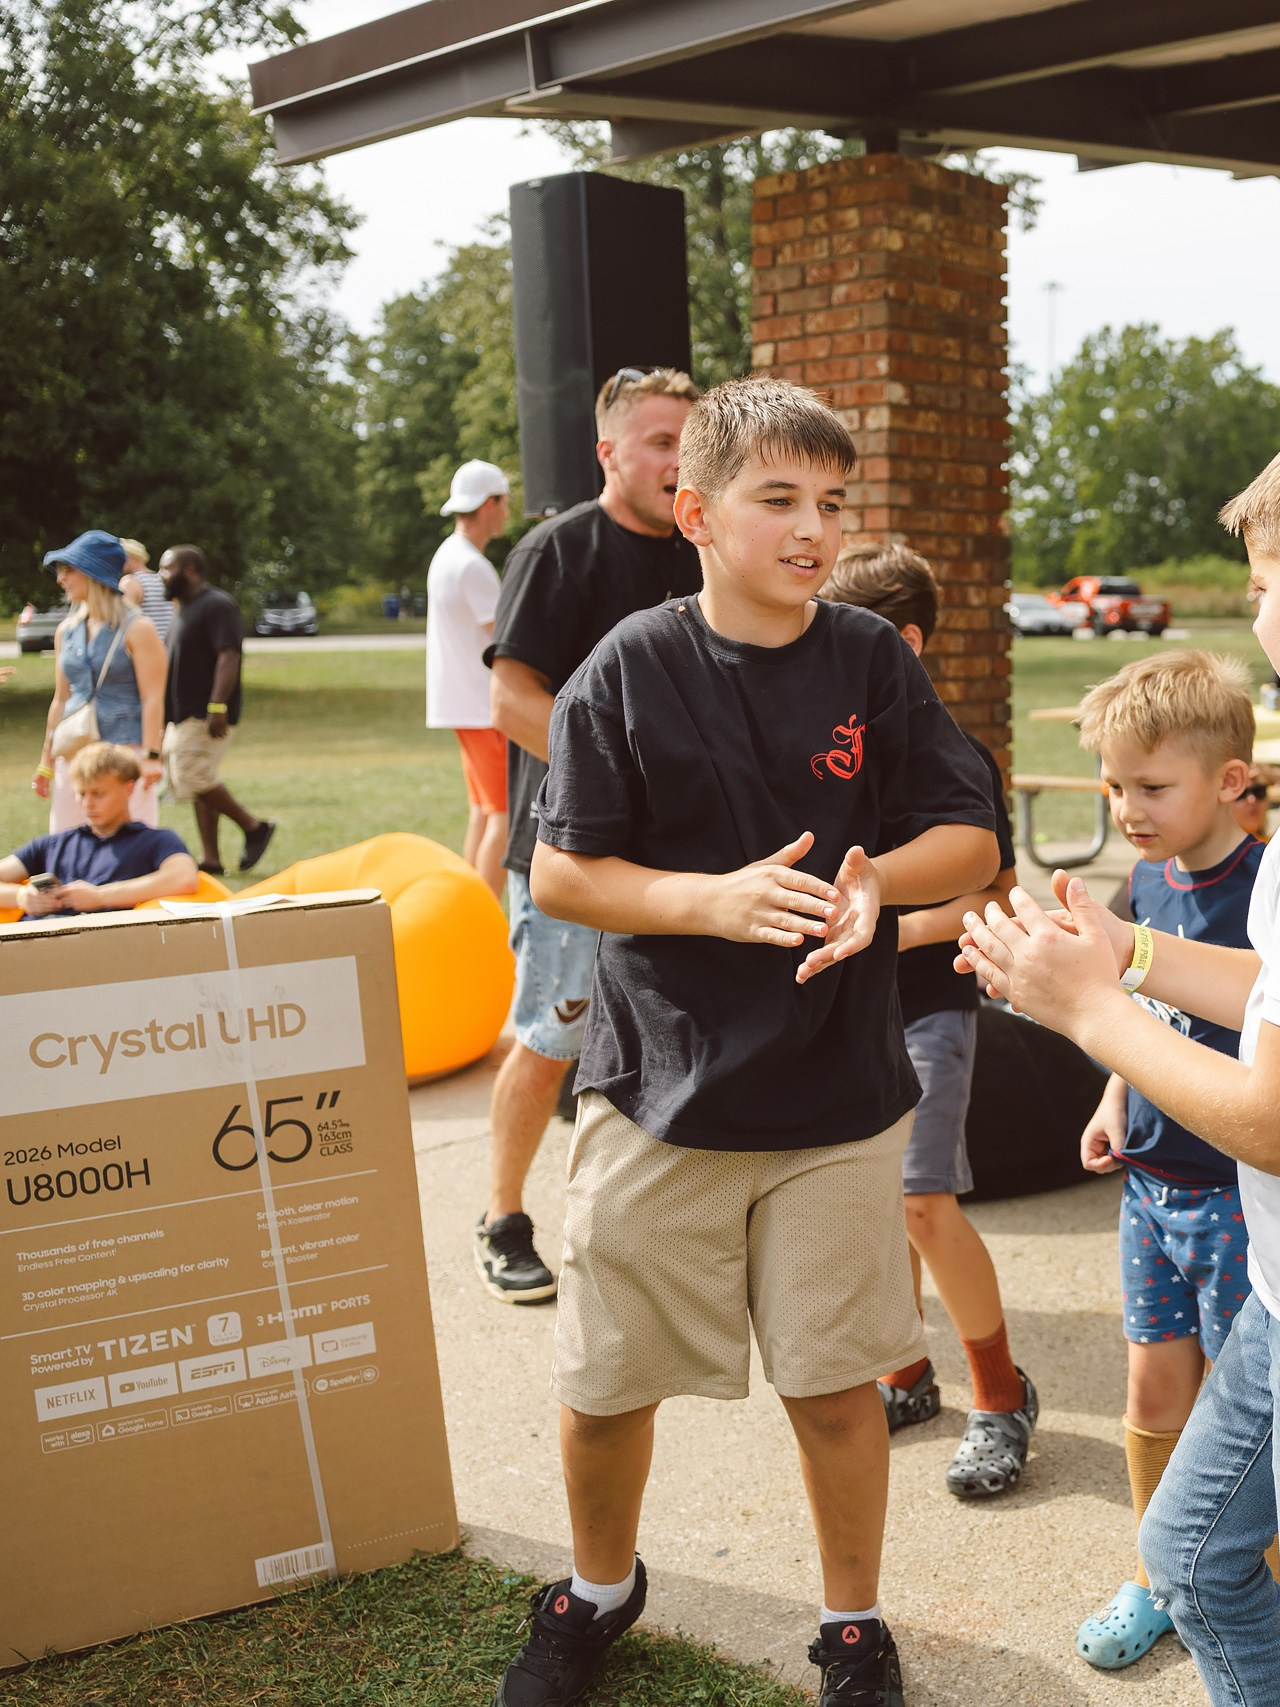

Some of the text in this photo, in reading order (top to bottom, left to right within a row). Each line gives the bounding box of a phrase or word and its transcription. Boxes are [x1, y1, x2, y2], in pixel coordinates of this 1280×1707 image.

[29, 1003, 306, 1075] Crystal UHD
[319, 1130, 352, 1142] 163cm
[4, 1135, 122, 1166] 2026 Model
[320, 1142, 353, 1157] CLASS
[6, 1158, 151, 1206] U8000H
[298, 1202, 323, 1213] clear
[324, 1196, 359, 1208] motion
[257, 1212, 331, 1230] Moon Xcelerator
[16, 1229, 165, 1261] Thousands of free channels
[299, 1238, 335, 1251] vibrant
[335, 1233, 360, 1245] color
[17, 1259, 54, 1273] Endless
[54, 1255, 76, 1266] Free
[286, 1252, 318, 1264] Booster
[22, 1257, 230, 1302] 3D color mapping & upscaling for clarity
[23, 1288, 118, 1312] Crystal Processor 4K
[256, 1315, 264, 1327] 3
[330, 1294, 371, 1312] PORTS
[218, 1317, 229, 1333] 7
[30, 1344, 92, 1365] Smart TV
[31, 1357, 94, 1375] Powered by
[190, 1361, 236, 1380] ESPN
[135, 1377, 168, 1391] YouTube
[46, 1388, 96, 1410] NETFLIX
